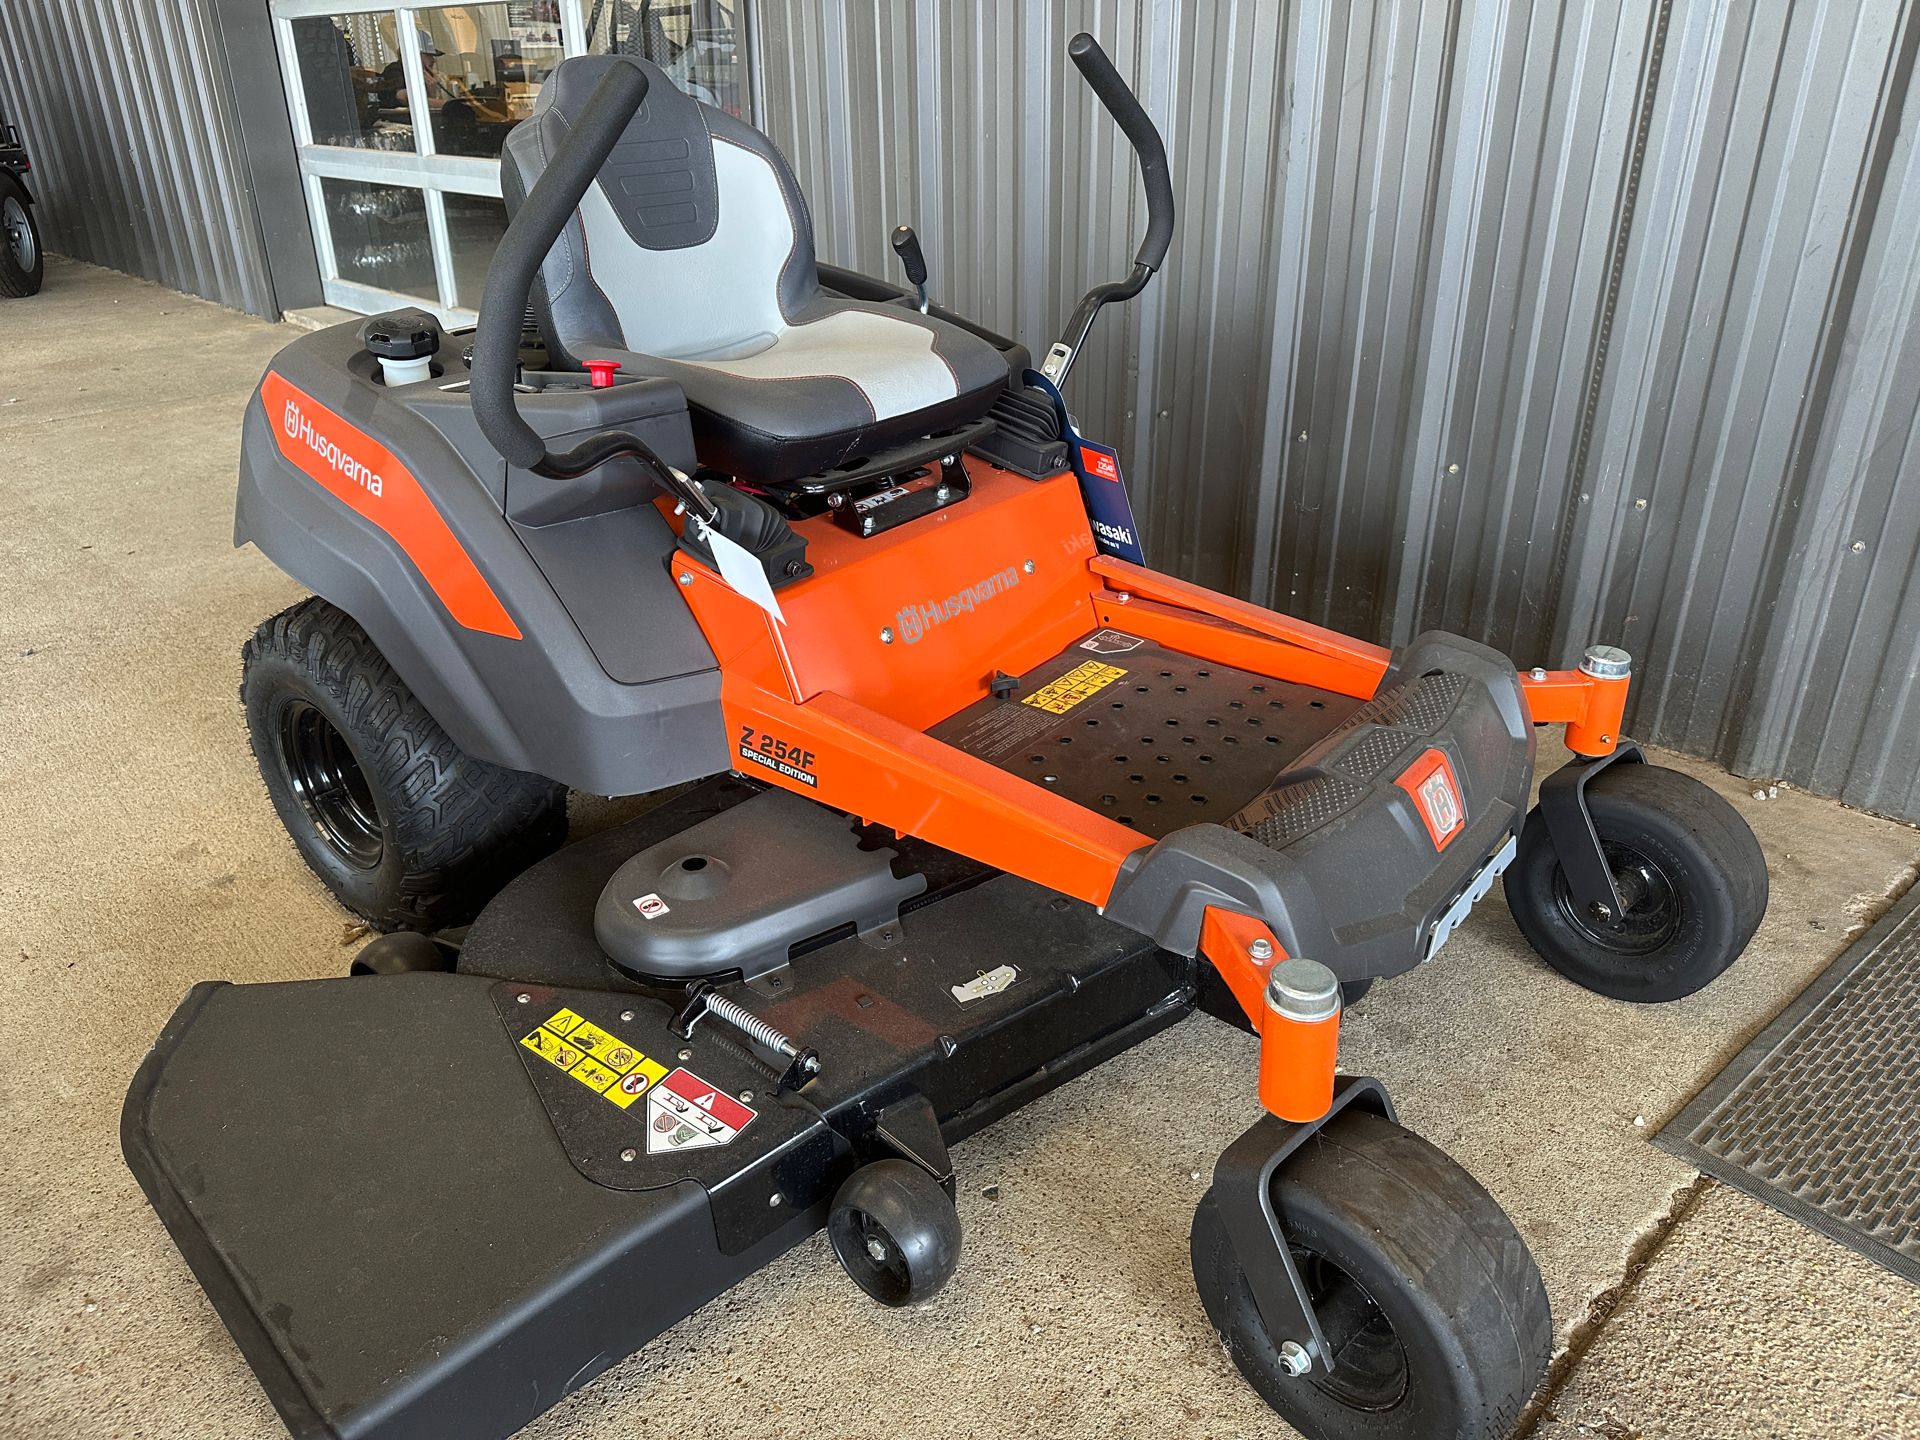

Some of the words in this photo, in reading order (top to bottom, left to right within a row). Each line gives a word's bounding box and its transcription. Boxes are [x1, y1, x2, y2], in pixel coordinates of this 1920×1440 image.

[299, 415, 383, 498] Husqvarna
[1092, 519, 1133, 545] wasaki
[919, 566, 1019, 630] Husqvarna
[740, 726, 755, 747] Z
[760, 734, 816, 769] 254F
[741, 747, 778, 769] SPECIAL
[778, 763, 815, 785] EDITION
